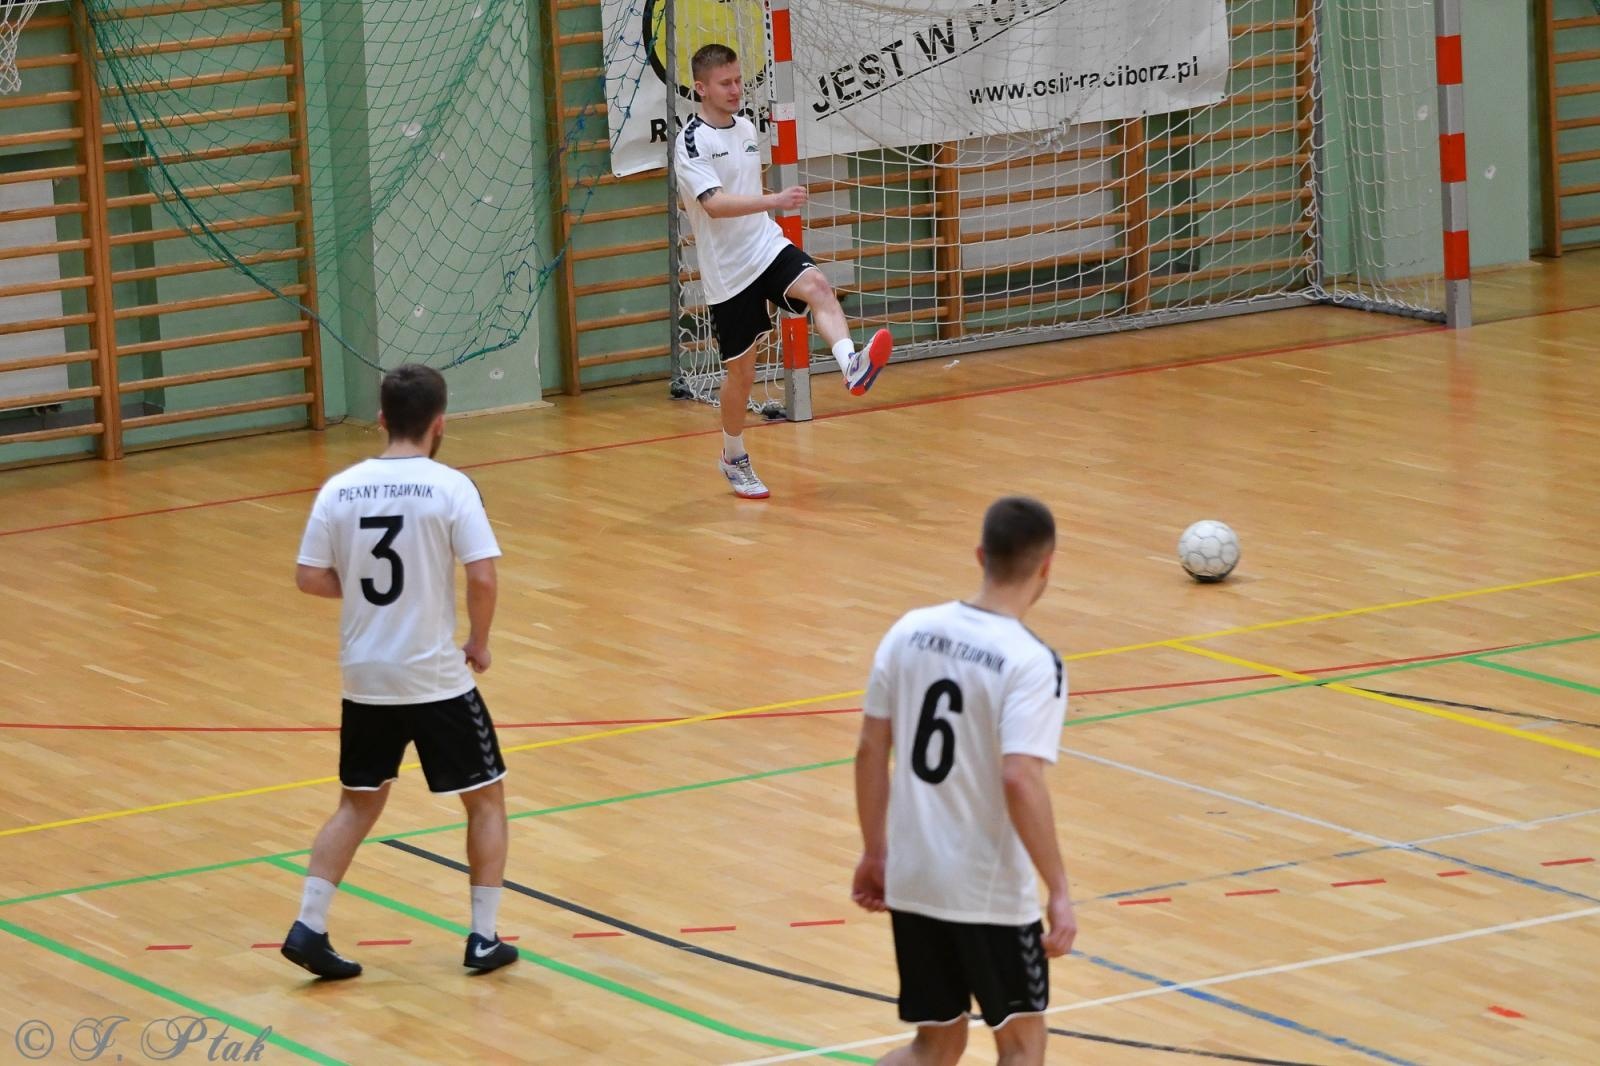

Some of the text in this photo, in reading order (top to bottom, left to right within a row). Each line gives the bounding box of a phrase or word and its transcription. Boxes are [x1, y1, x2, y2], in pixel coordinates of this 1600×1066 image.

[812, 39, 904, 113] JEST
[912, 18, 955, 62] W
[969, 55, 1199, 105] www.osir-raciborz.pl
[383, 483, 435, 499] TRAWNIK
[359, 515, 405, 606] 3
[912, 678, 964, 785] 6
